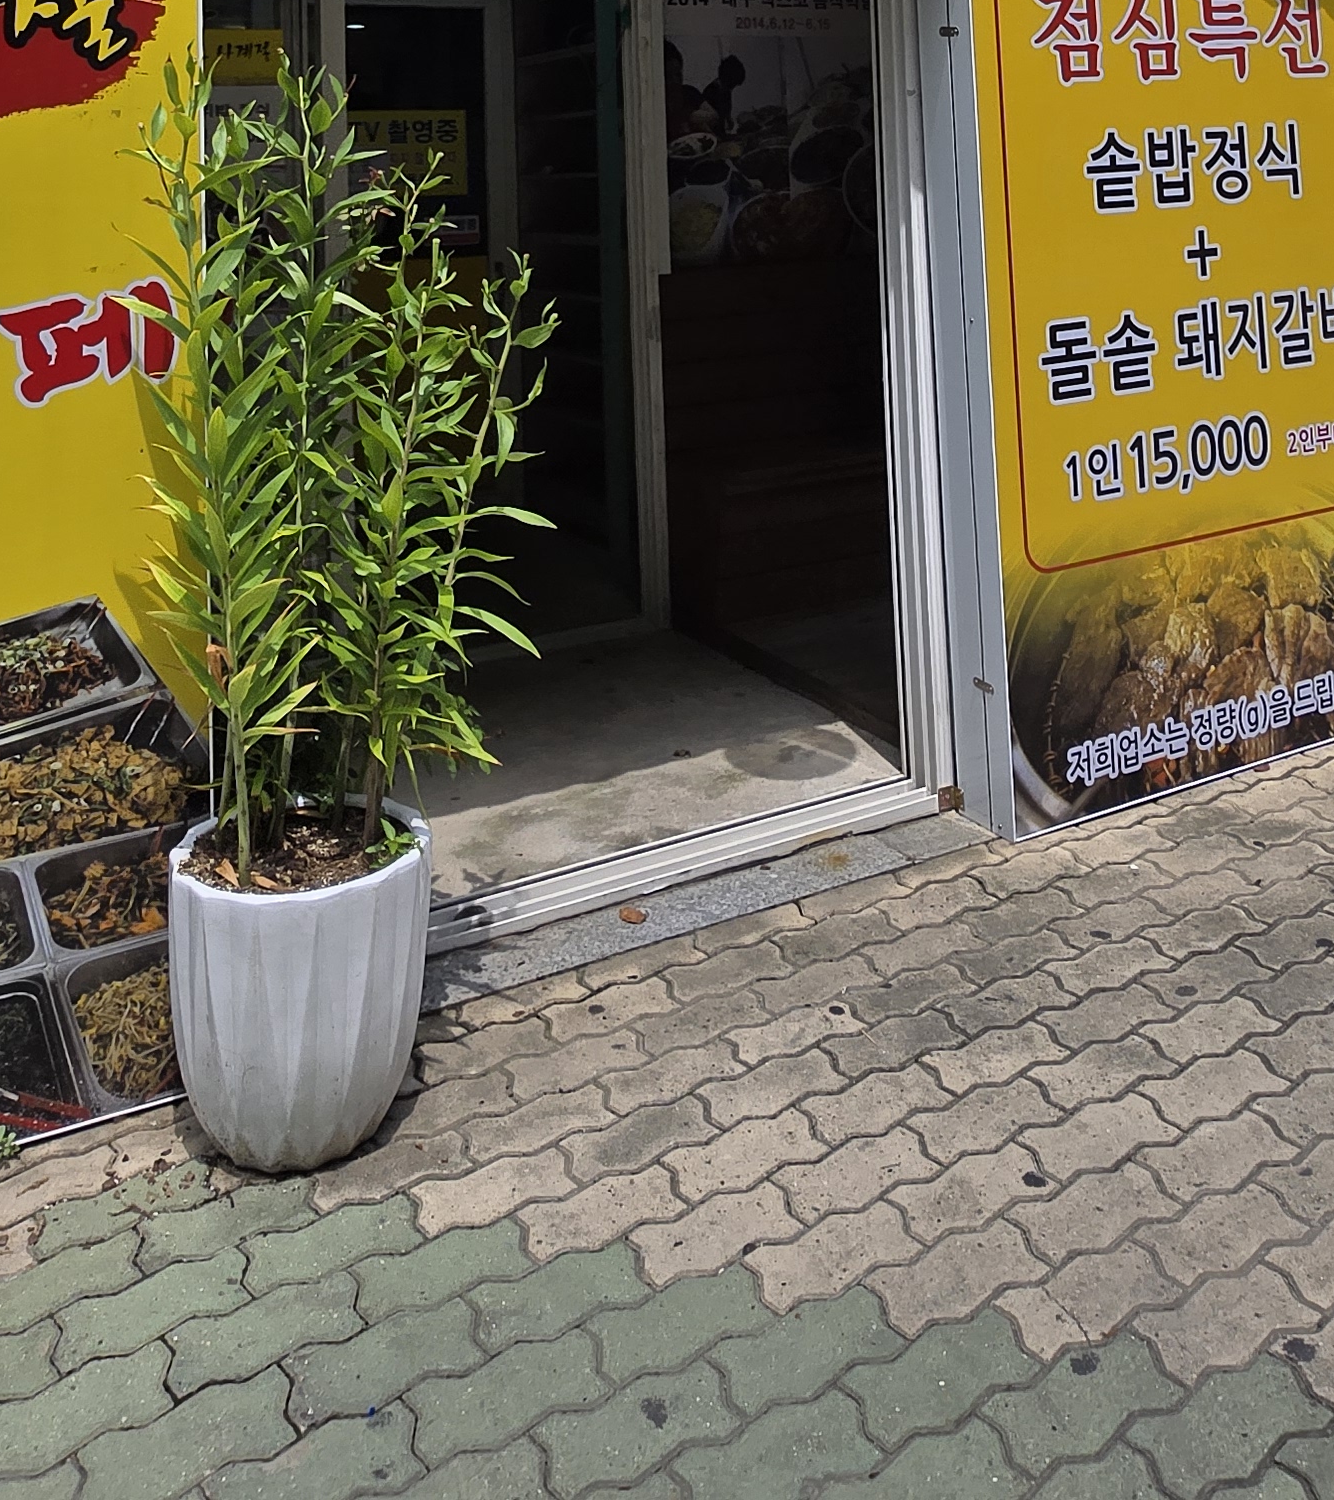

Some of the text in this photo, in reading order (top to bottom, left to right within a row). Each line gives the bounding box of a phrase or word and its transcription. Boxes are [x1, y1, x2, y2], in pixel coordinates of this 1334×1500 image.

[388, 119, 459, 144] 촬영중
[1084, 121, 1303, 213] 솥밥정식
[1041, 312, 1156, 403] 돌솥
[1068, 718, 1188, 784] 저희업소는
